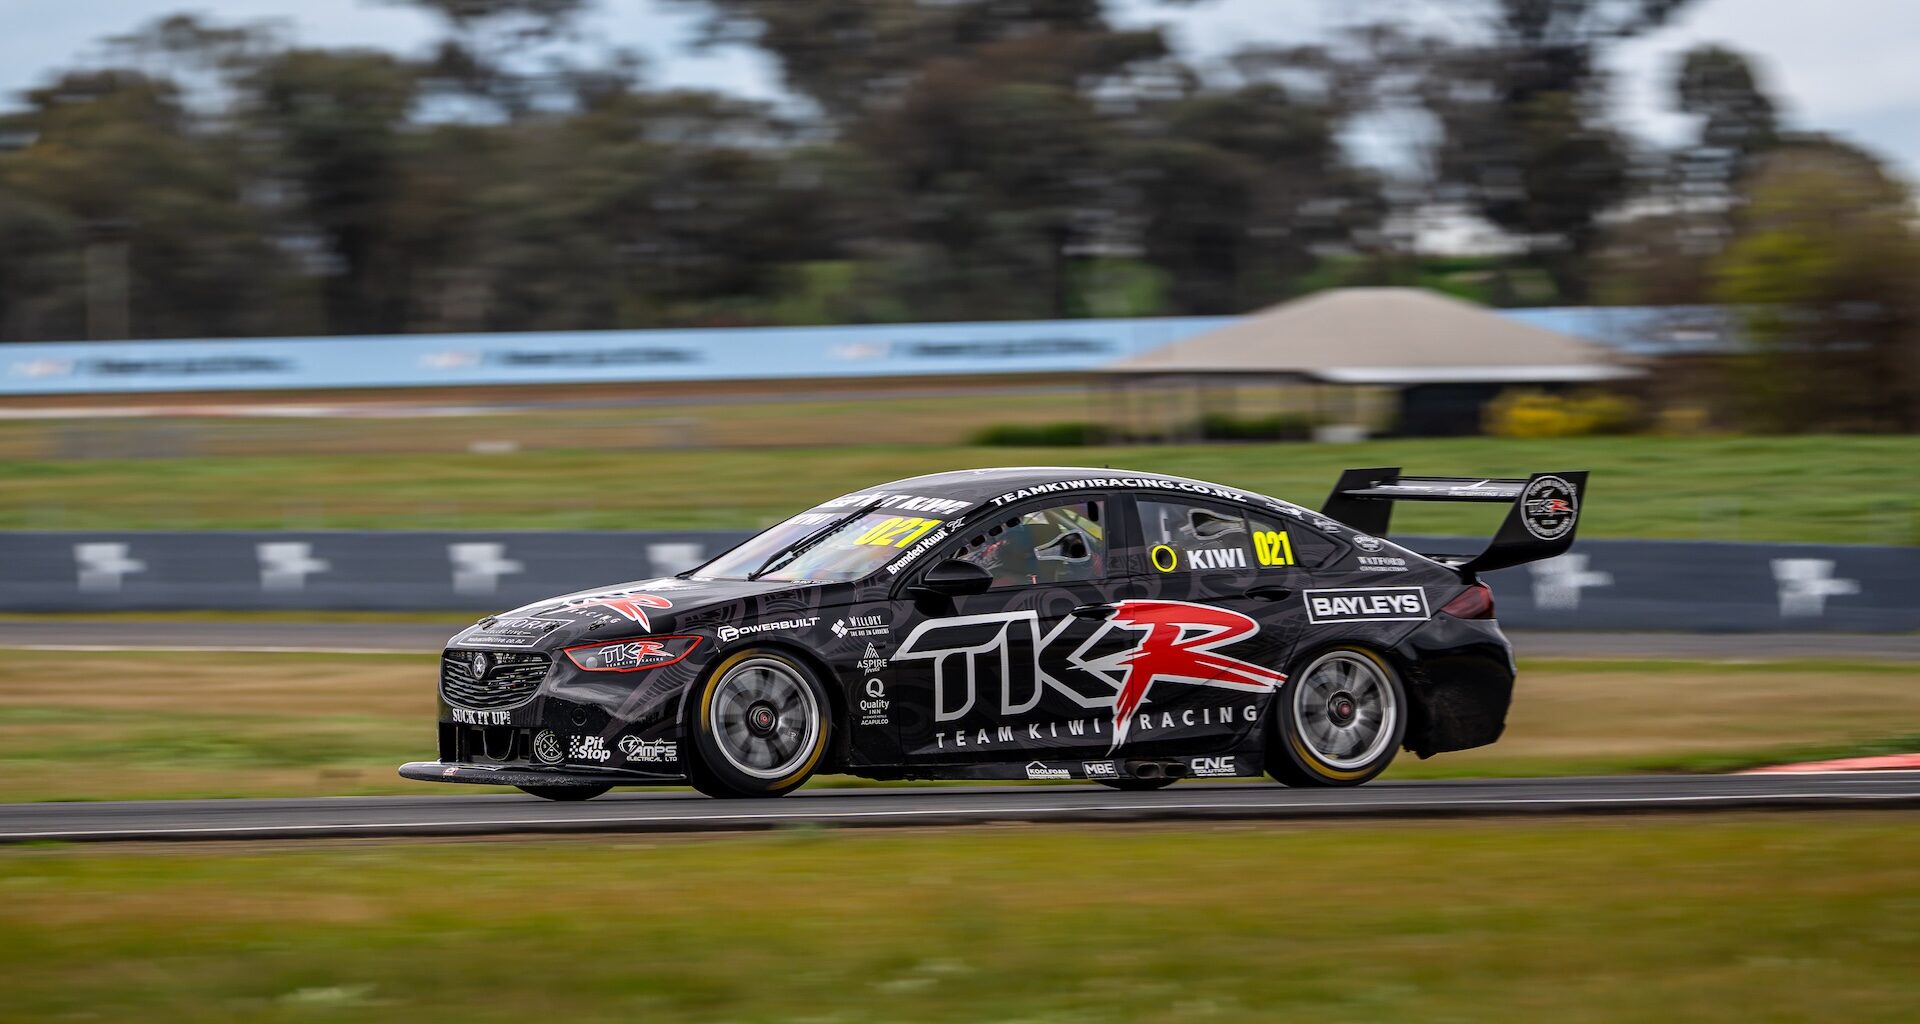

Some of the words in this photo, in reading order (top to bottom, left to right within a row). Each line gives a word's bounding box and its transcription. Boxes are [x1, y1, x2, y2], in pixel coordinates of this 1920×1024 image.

[990, 478, 1248, 507] TEAMKIWIRACING.CO.NZ
[852, 517, 943, 548] 021
[1252, 530, 1295, 566] 021
[886, 544, 926, 576] Branded
[1187, 548, 1247, 570] KIWI
[1311, 594, 1421, 616] BAYLEYS
[717, 617, 820, 642] POWERBUILT
[848, 615, 882, 627] WILLORY
[597, 641, 676, 667] TKR
[856, 659, 888, 669] ASPIRE
[890, 599, 1289, 756] TKR
[866, 678, 886, 698] Q
[860, 699, 890, 711] Quality
[452, 708, 476, 725] SUCK
[477, 711, 490, 726] IT
[491, 711, 507, 726] UP
[860, 718, 889, 726] ACAPULCO
[936, 726, 1014, 749] TEAM
[1028, 718, 1100, 740] KIWI
[1139, 704, 1259, 731] RACING
[585, 736, 605, 750] Pit
[629, 745, 677, 758] AMPS
[578, 745, 611, 763] Stop
[1190, 756, 1236, 770] CNC
[1084, 763, 1115, 774] MBE
